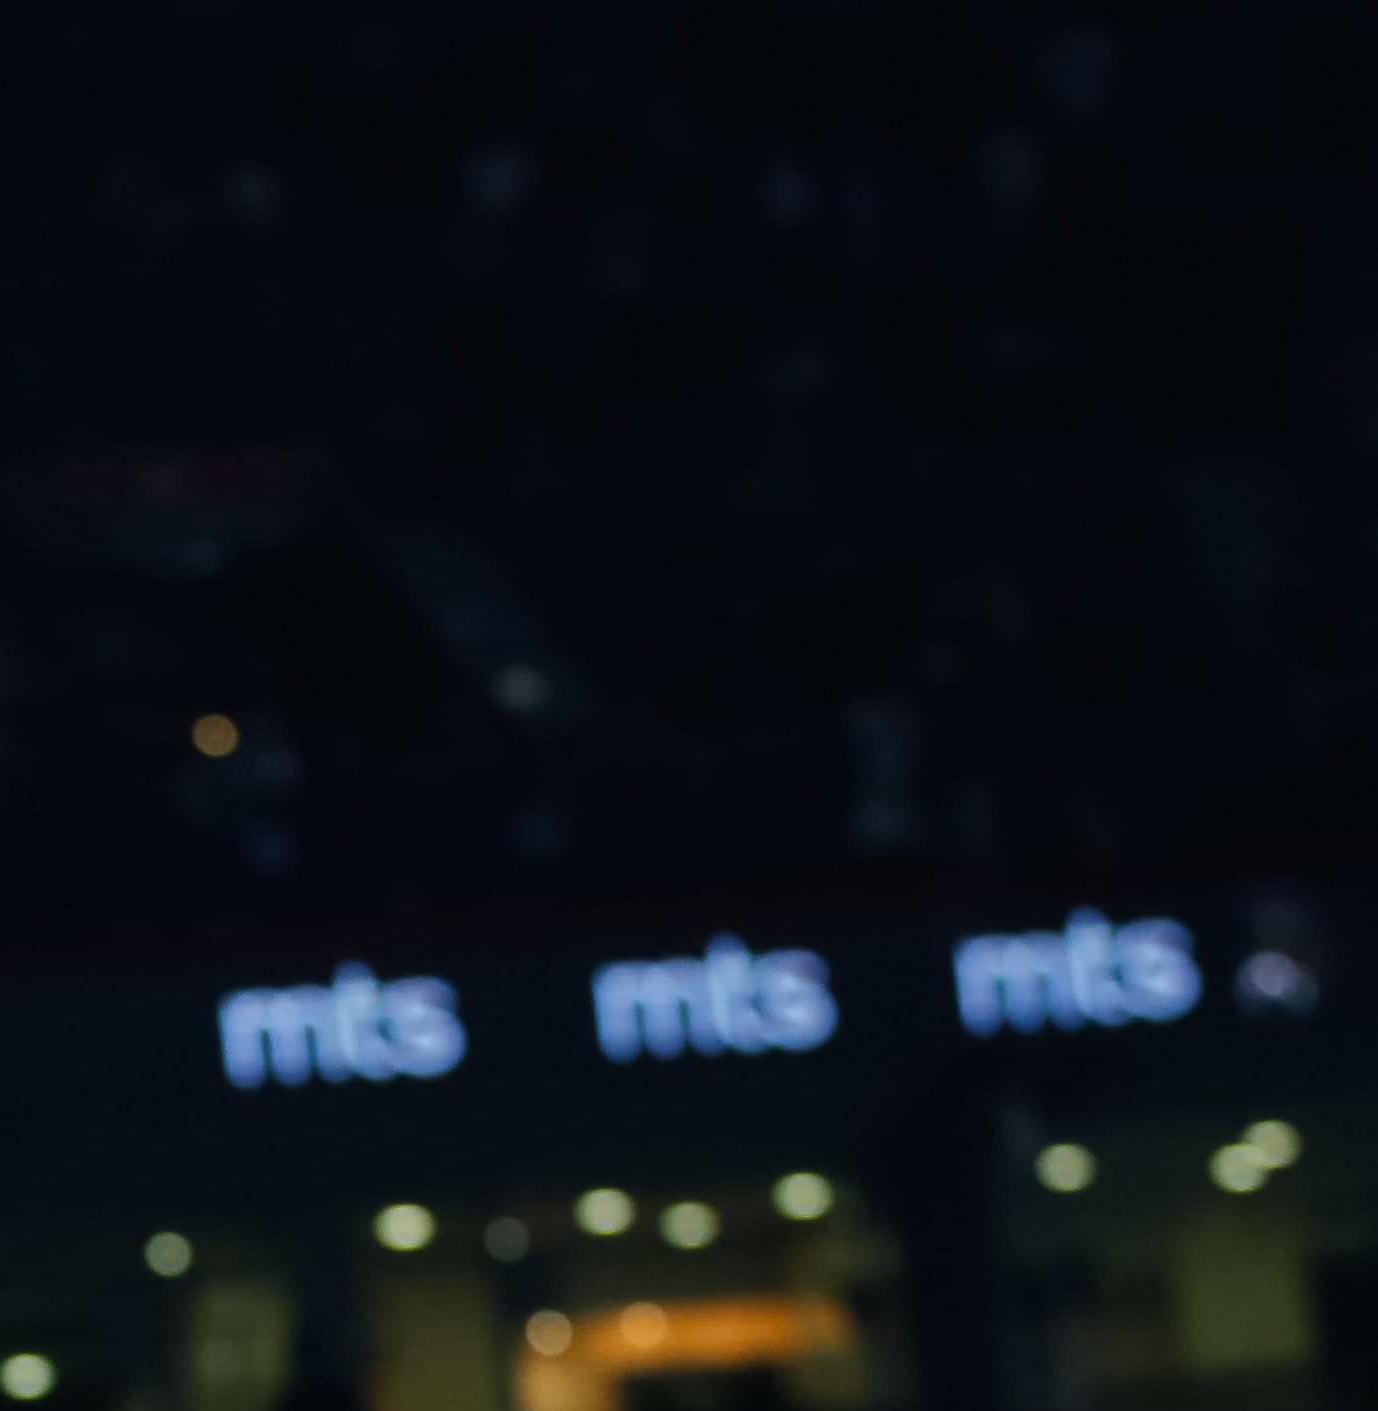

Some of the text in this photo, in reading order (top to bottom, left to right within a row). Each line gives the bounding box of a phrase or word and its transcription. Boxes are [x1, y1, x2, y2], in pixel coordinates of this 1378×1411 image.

[218, 963, 466, 1086] mts
[593, 937, 837, 1059] mts
[953, 909, 1201, 1034] mts
